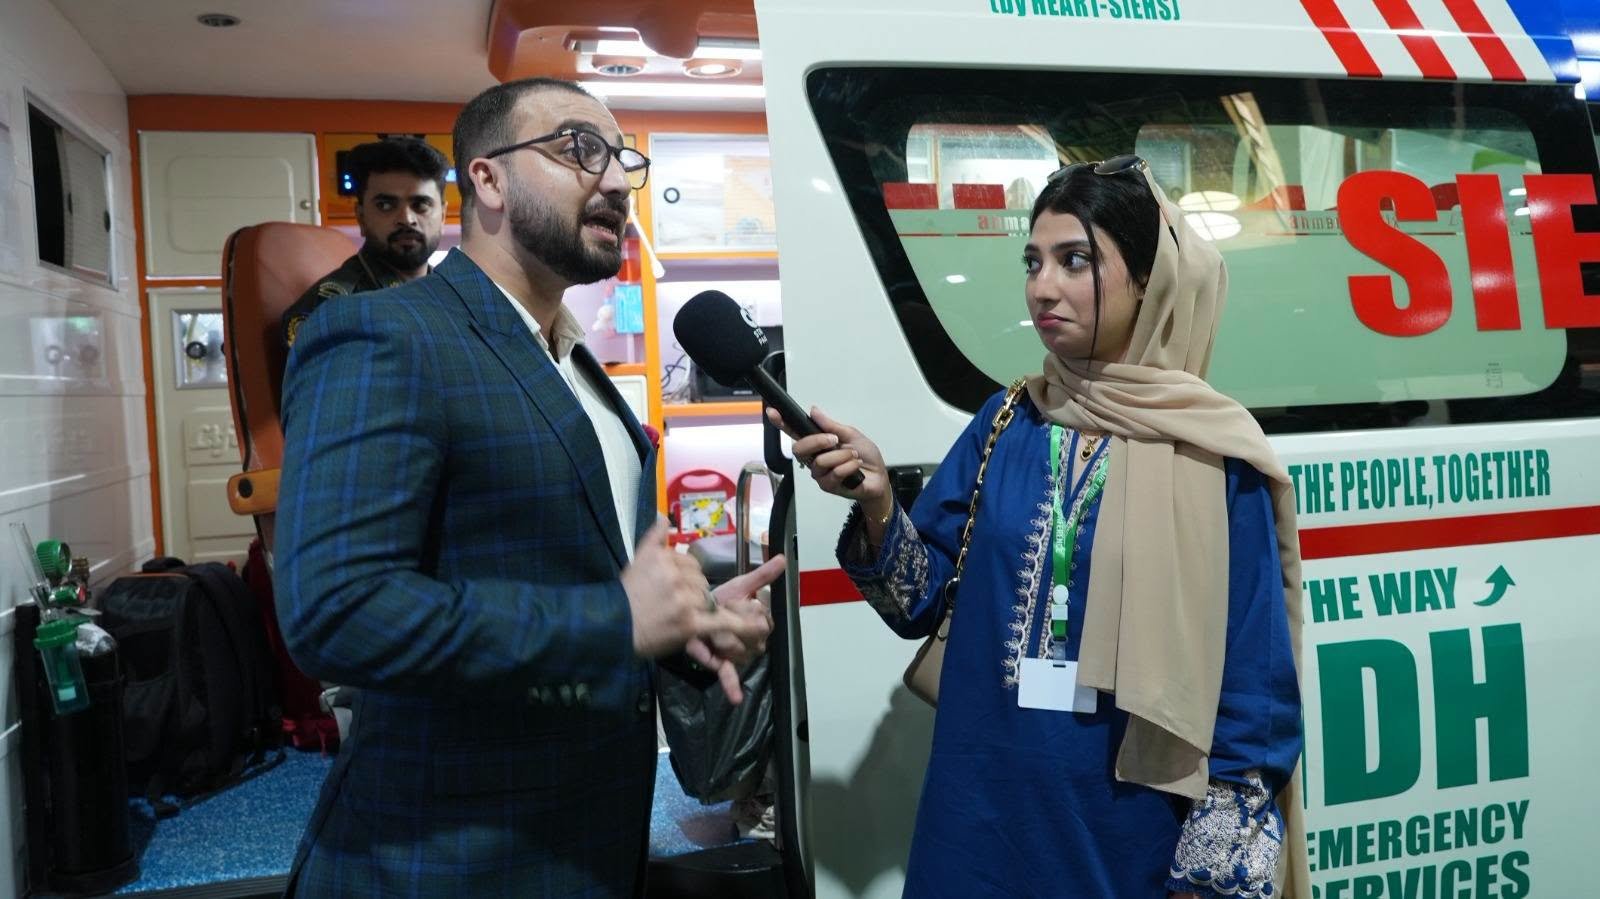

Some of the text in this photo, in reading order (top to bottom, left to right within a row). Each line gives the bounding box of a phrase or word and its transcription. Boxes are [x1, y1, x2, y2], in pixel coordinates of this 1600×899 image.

[1336, 170, 1600, 338] SIE
[1288, 449, 1551, 515] THE PEOPLE, TOGETHER
[1303, 567, 1458, 624] HE WAY
[1303, 622, 1529, 810] DH
[1312, 850, 1530, 899] VICES
